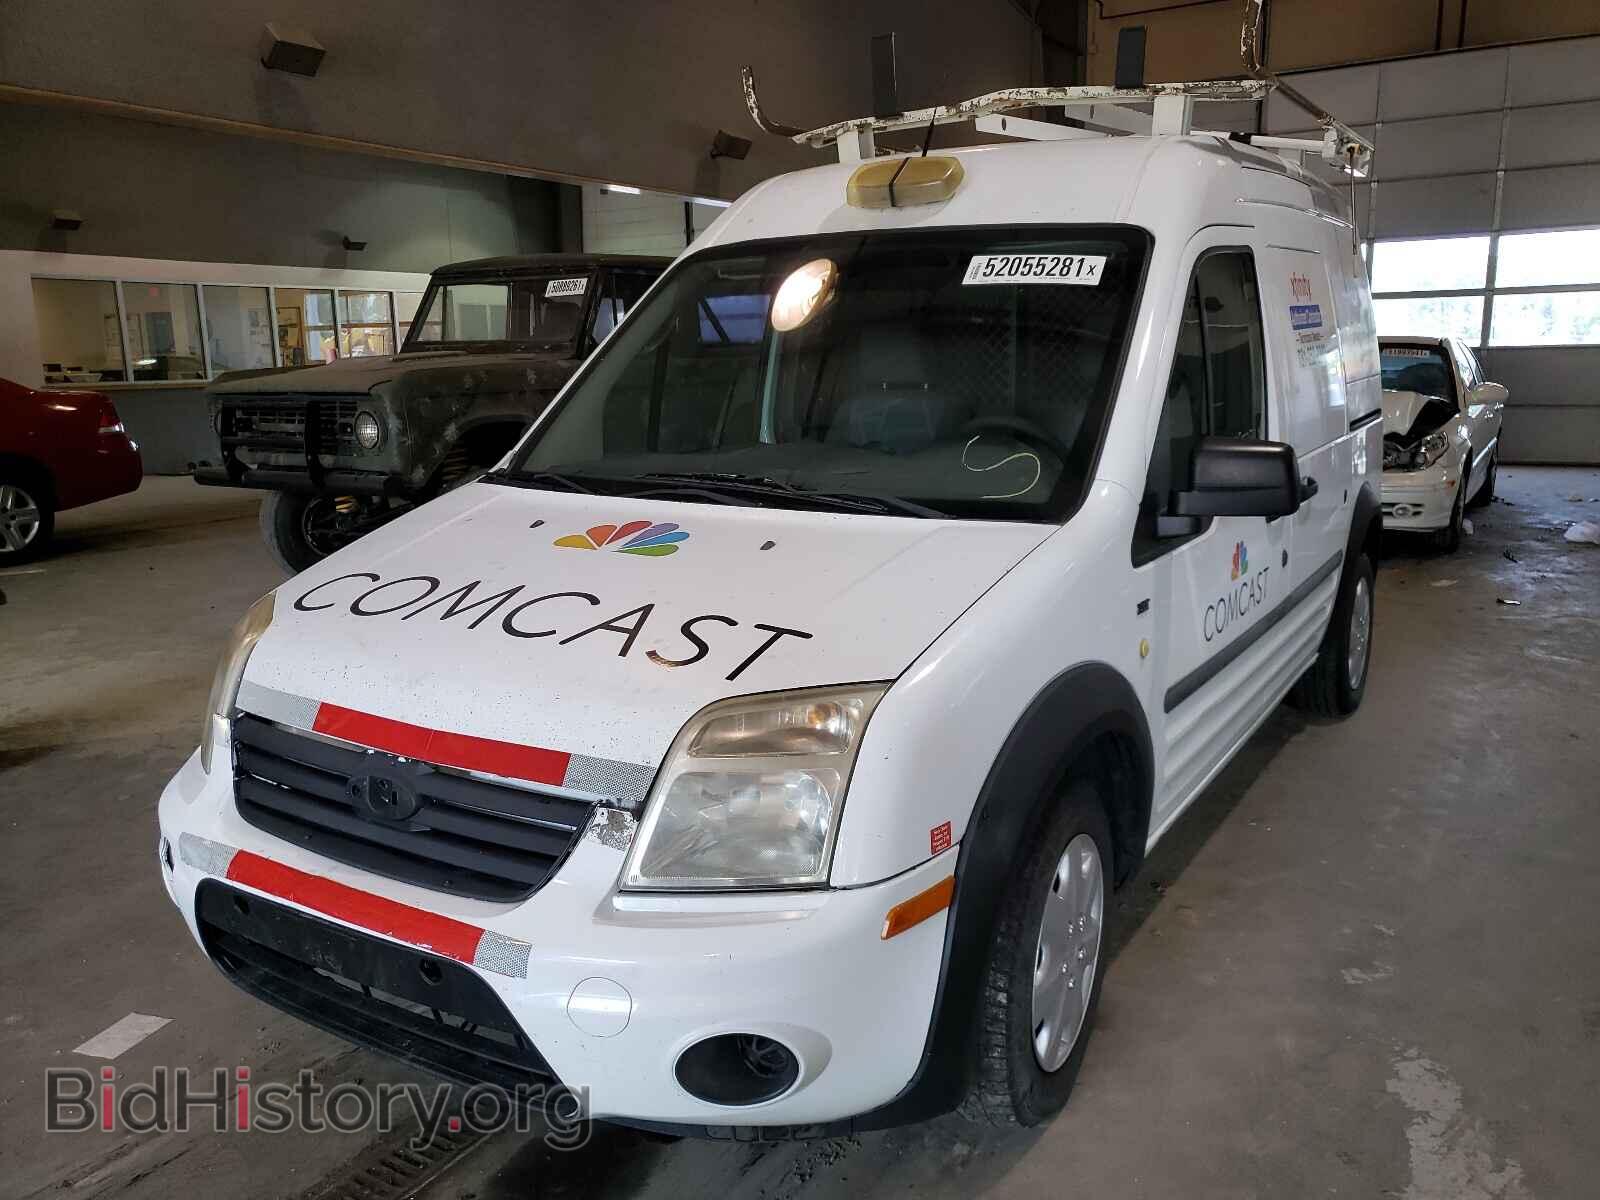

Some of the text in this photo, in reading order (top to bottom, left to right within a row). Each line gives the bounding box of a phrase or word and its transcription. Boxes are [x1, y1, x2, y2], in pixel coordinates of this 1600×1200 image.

[983, 257, 1085, 277] 52055281
[293, 572, 814, 682] COMCAST
[1203, 566, 1270, 642] COMCAST
